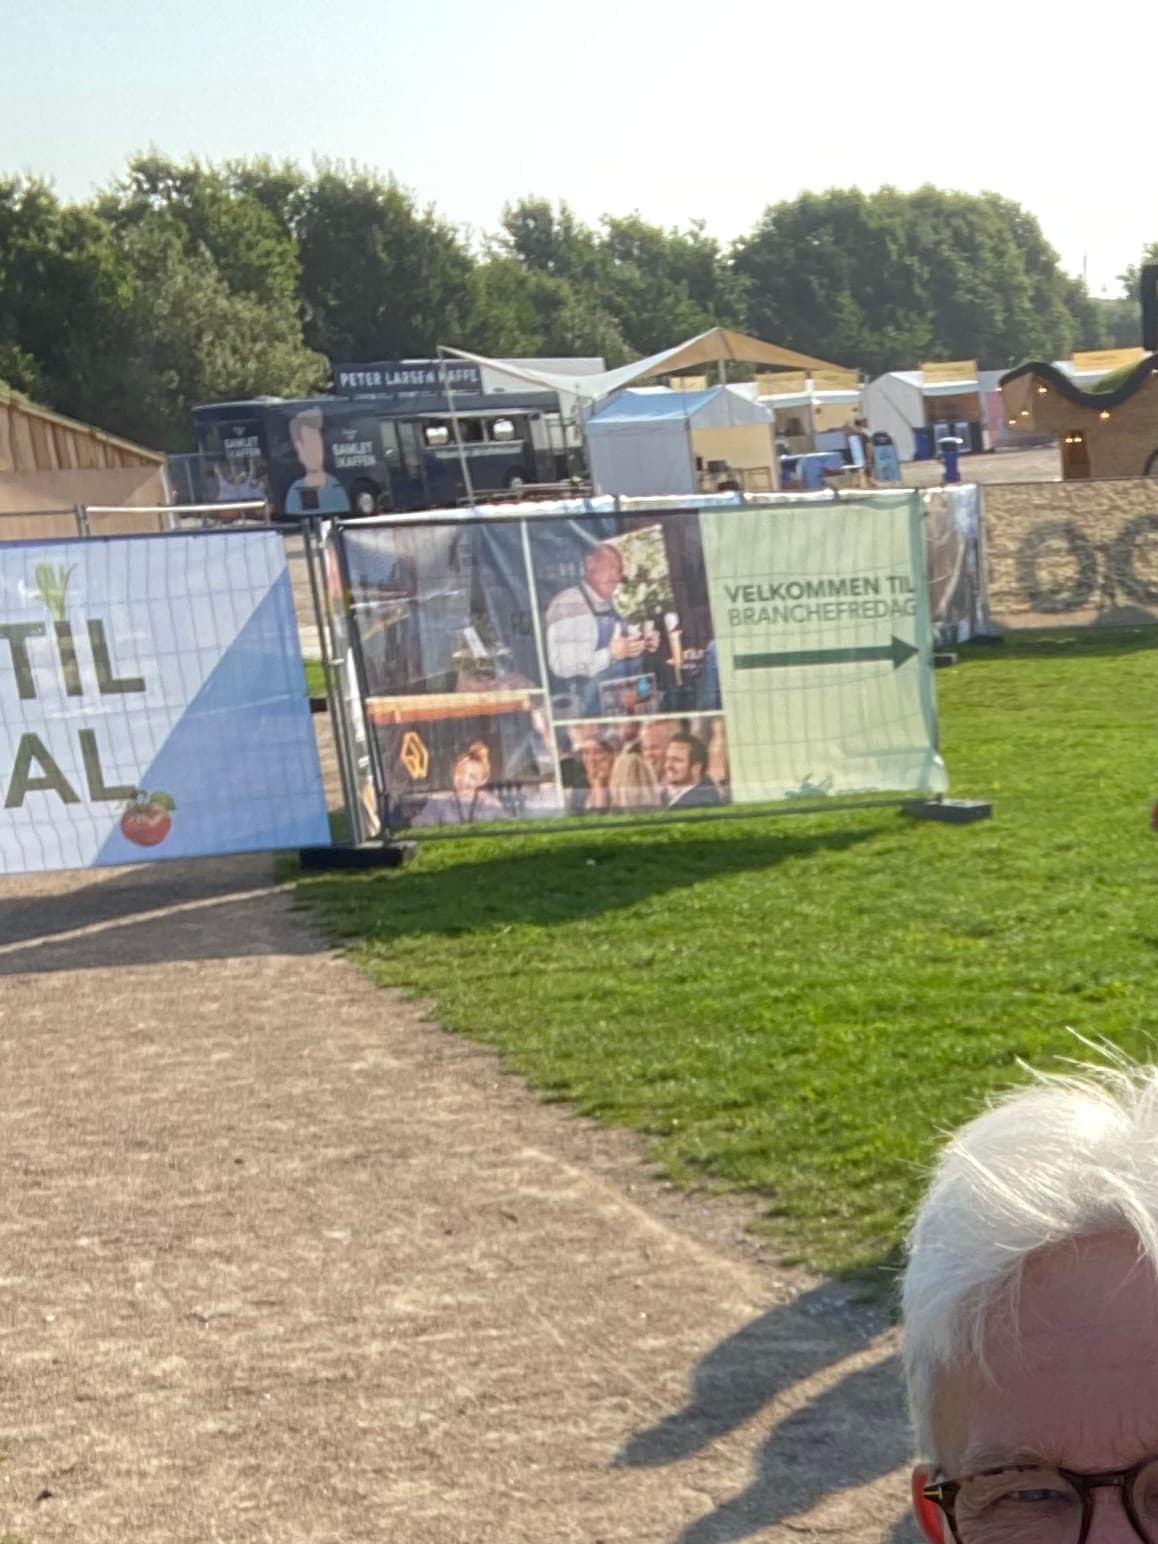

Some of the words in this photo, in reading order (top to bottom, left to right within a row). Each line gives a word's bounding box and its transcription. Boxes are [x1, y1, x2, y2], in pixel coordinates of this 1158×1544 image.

[340, 372, 381, 387] PETER
[385, 371, 434, 385] LARSEN
[724, 578, 880, 602] VELKOMMEN
[887, 576, 916, 594] TIL
[728, 598, 917, 627] BRANCHEFREDAG
[0, 618, 146, 699] TIL
[5, 728, 141, 808] AL
